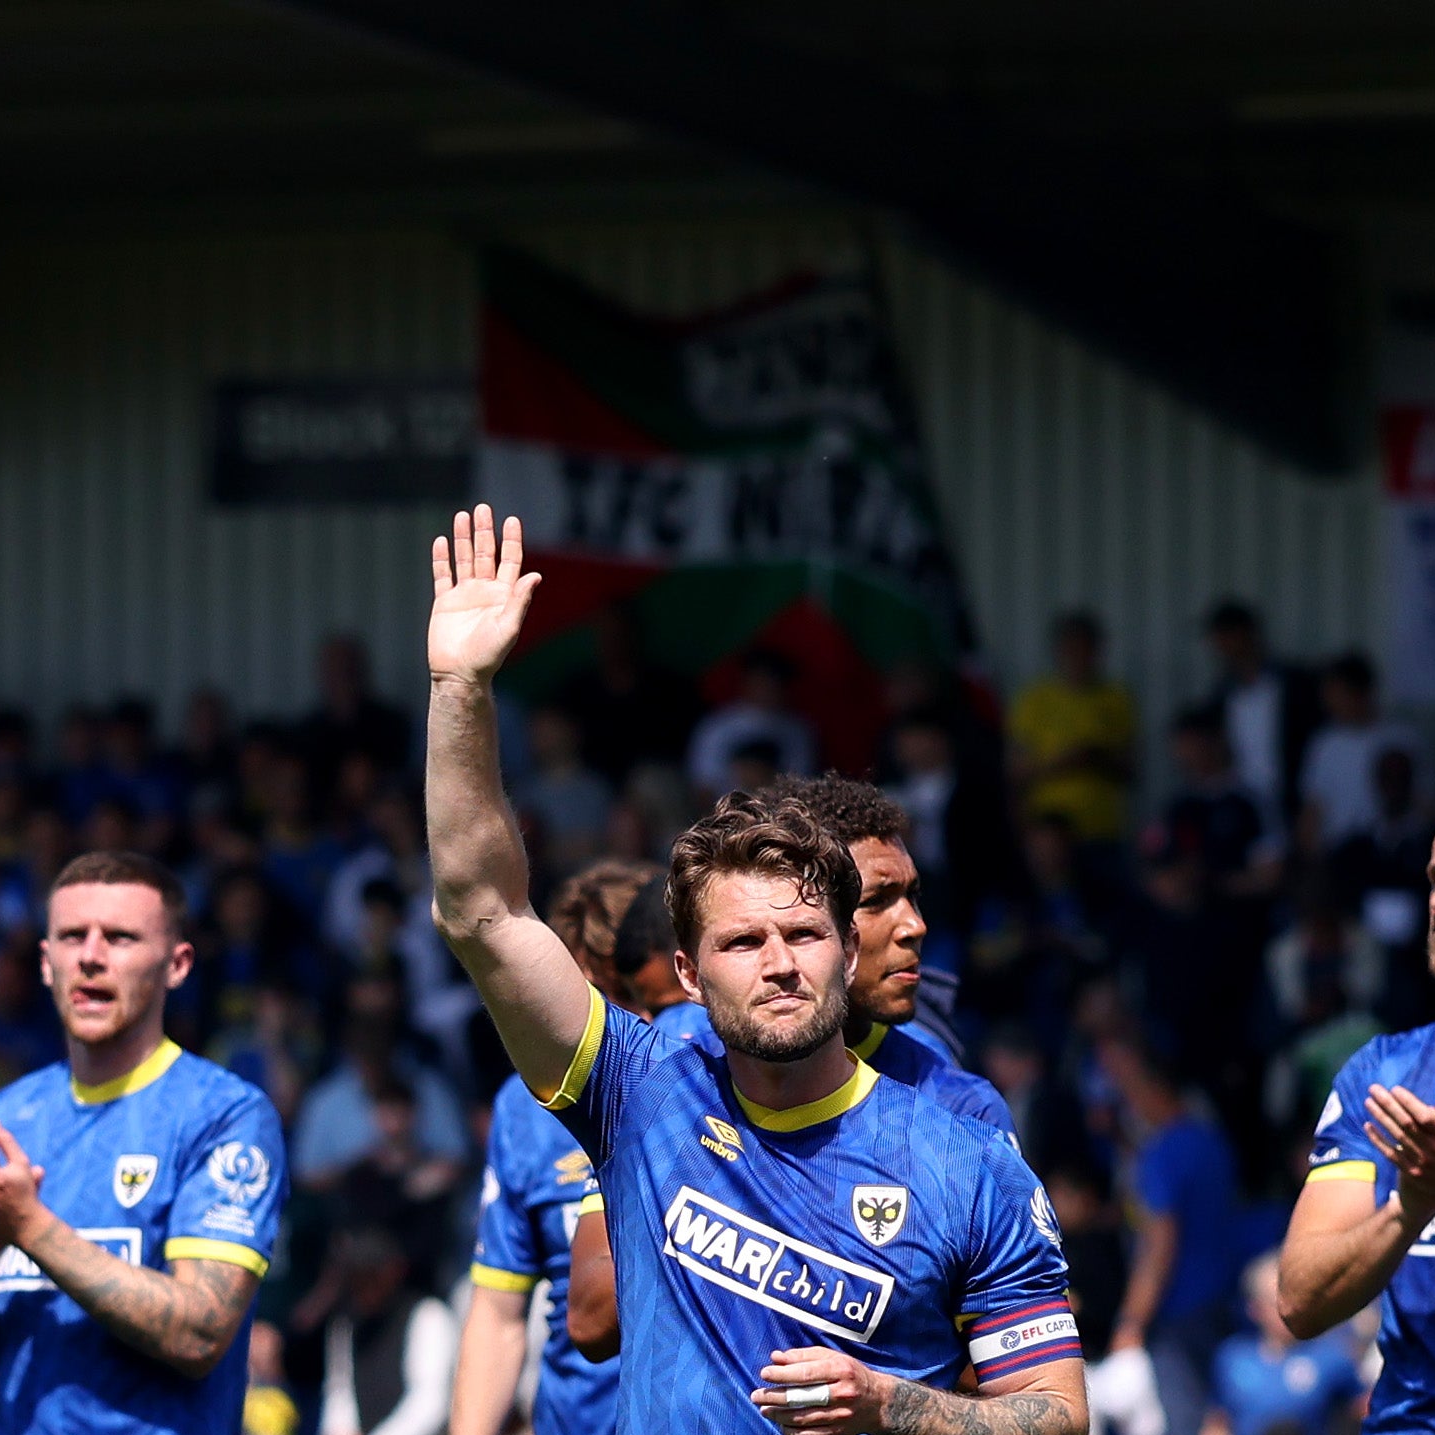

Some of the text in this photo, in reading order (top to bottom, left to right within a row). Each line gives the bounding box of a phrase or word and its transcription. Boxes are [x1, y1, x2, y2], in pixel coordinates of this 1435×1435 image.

[700, 1134, 739, 1162] umbro
[673, 1205, 873, 1323] WAR child
[1021, 1318, 1077, 1341] EFL CAPTA
